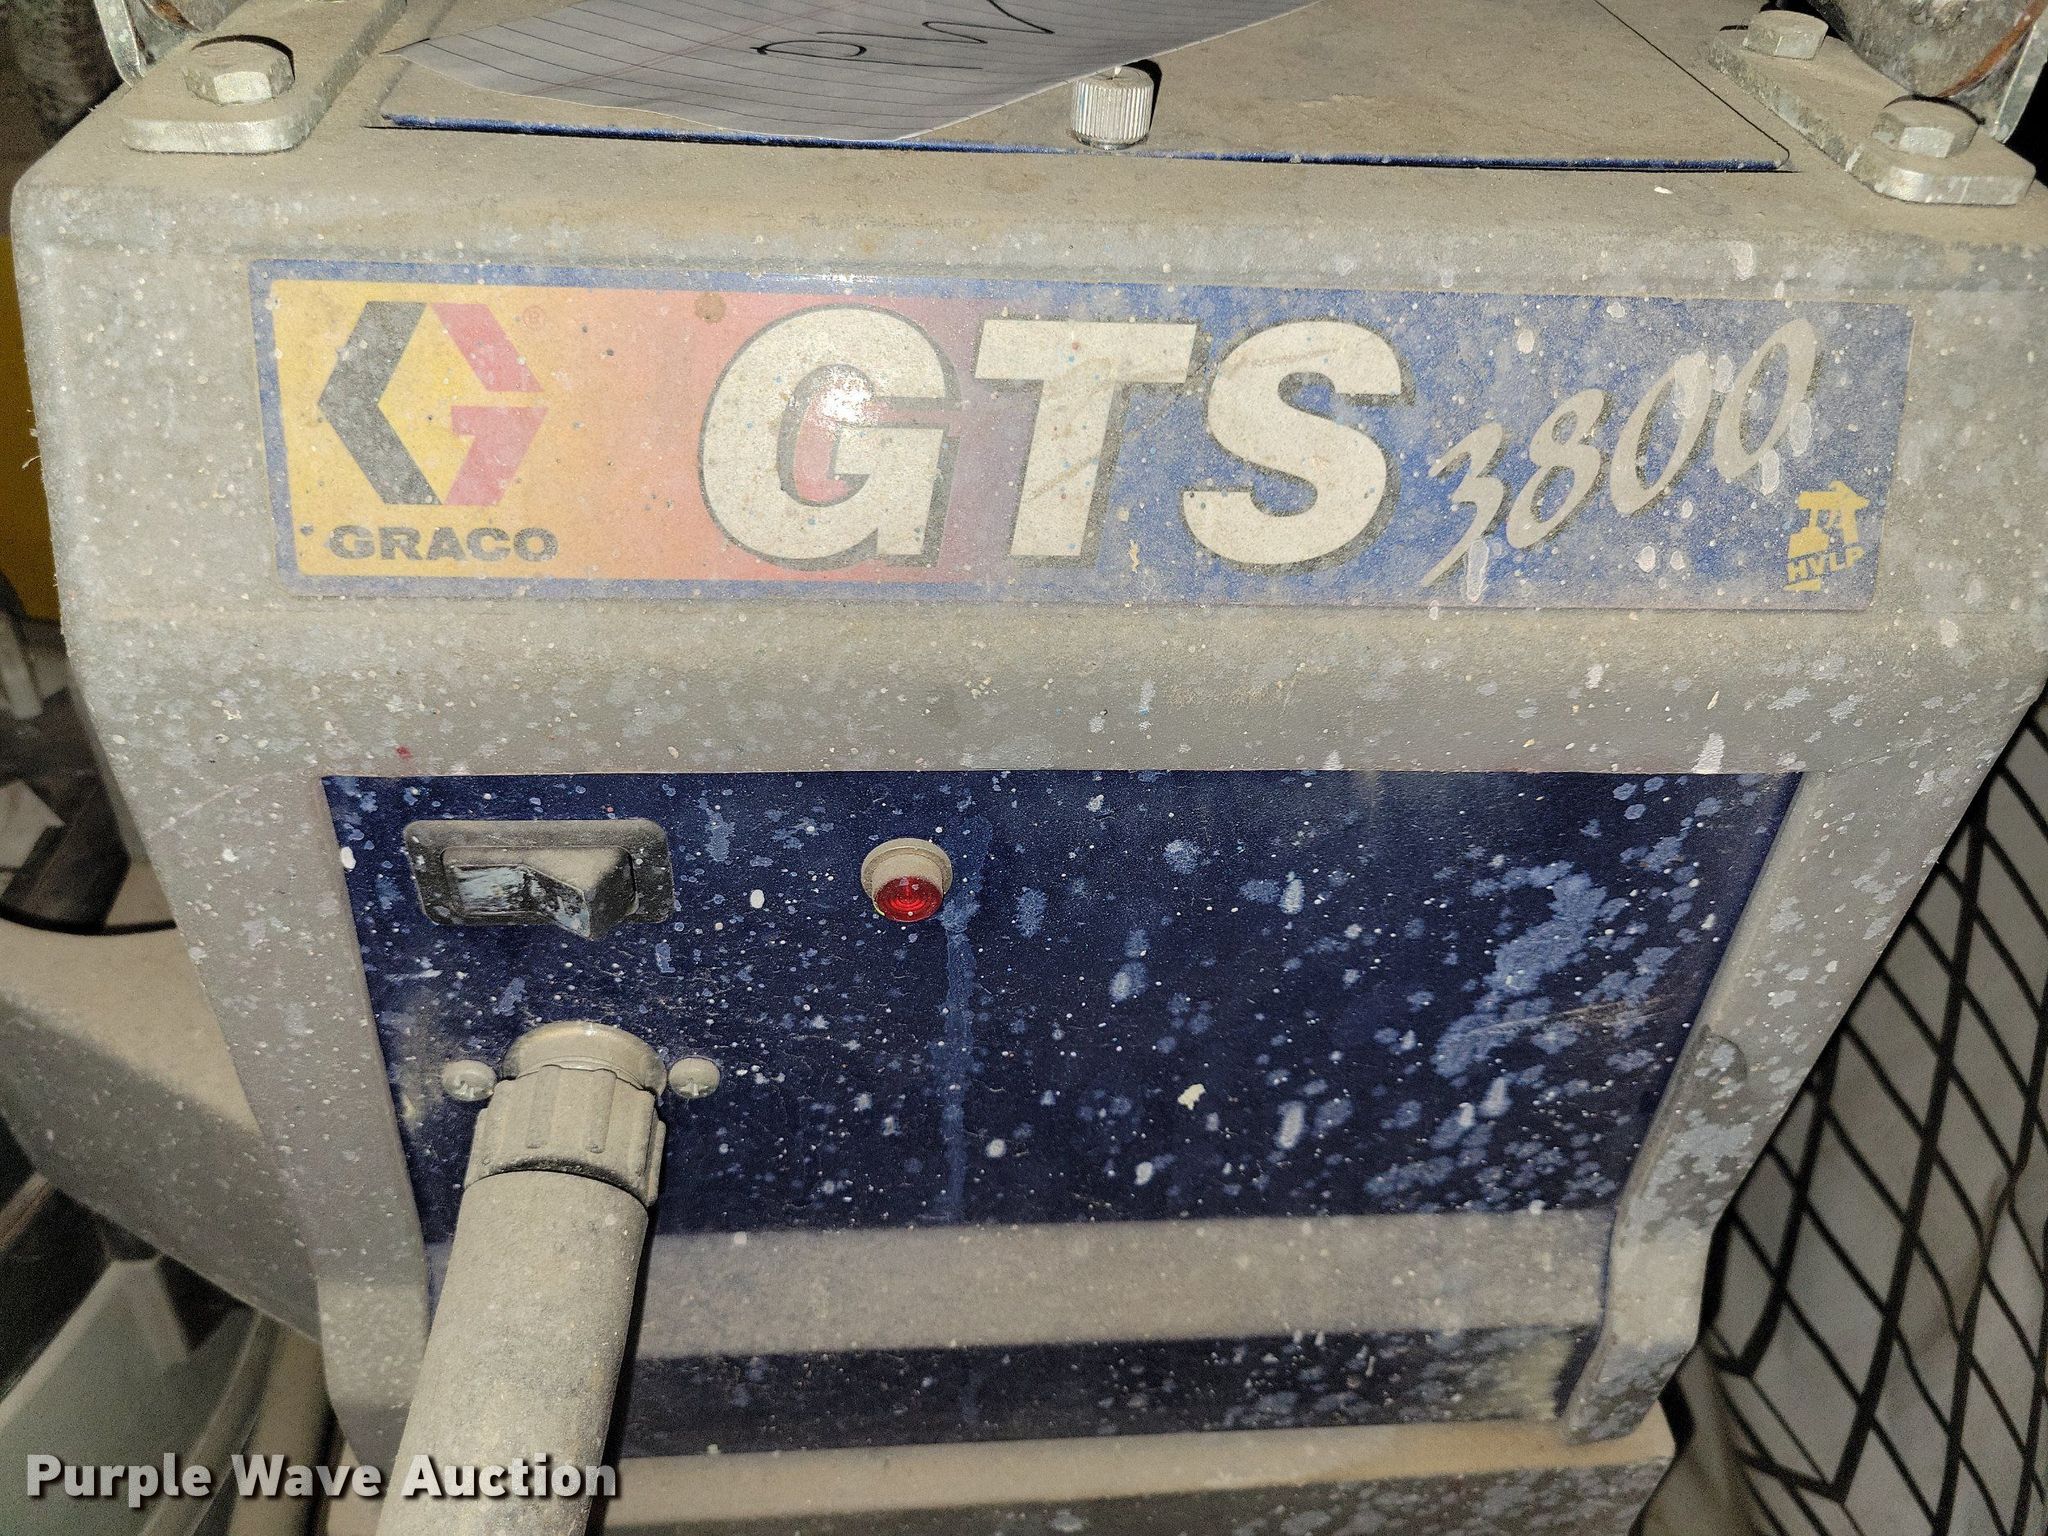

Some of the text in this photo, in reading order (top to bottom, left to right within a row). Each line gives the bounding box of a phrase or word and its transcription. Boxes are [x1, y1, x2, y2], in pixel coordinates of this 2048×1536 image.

[699, 304, 1821, 587] GTS 3800
[329, 525, 558, 563] GRACO
[1786, 546, 1866, 582] HVLP
